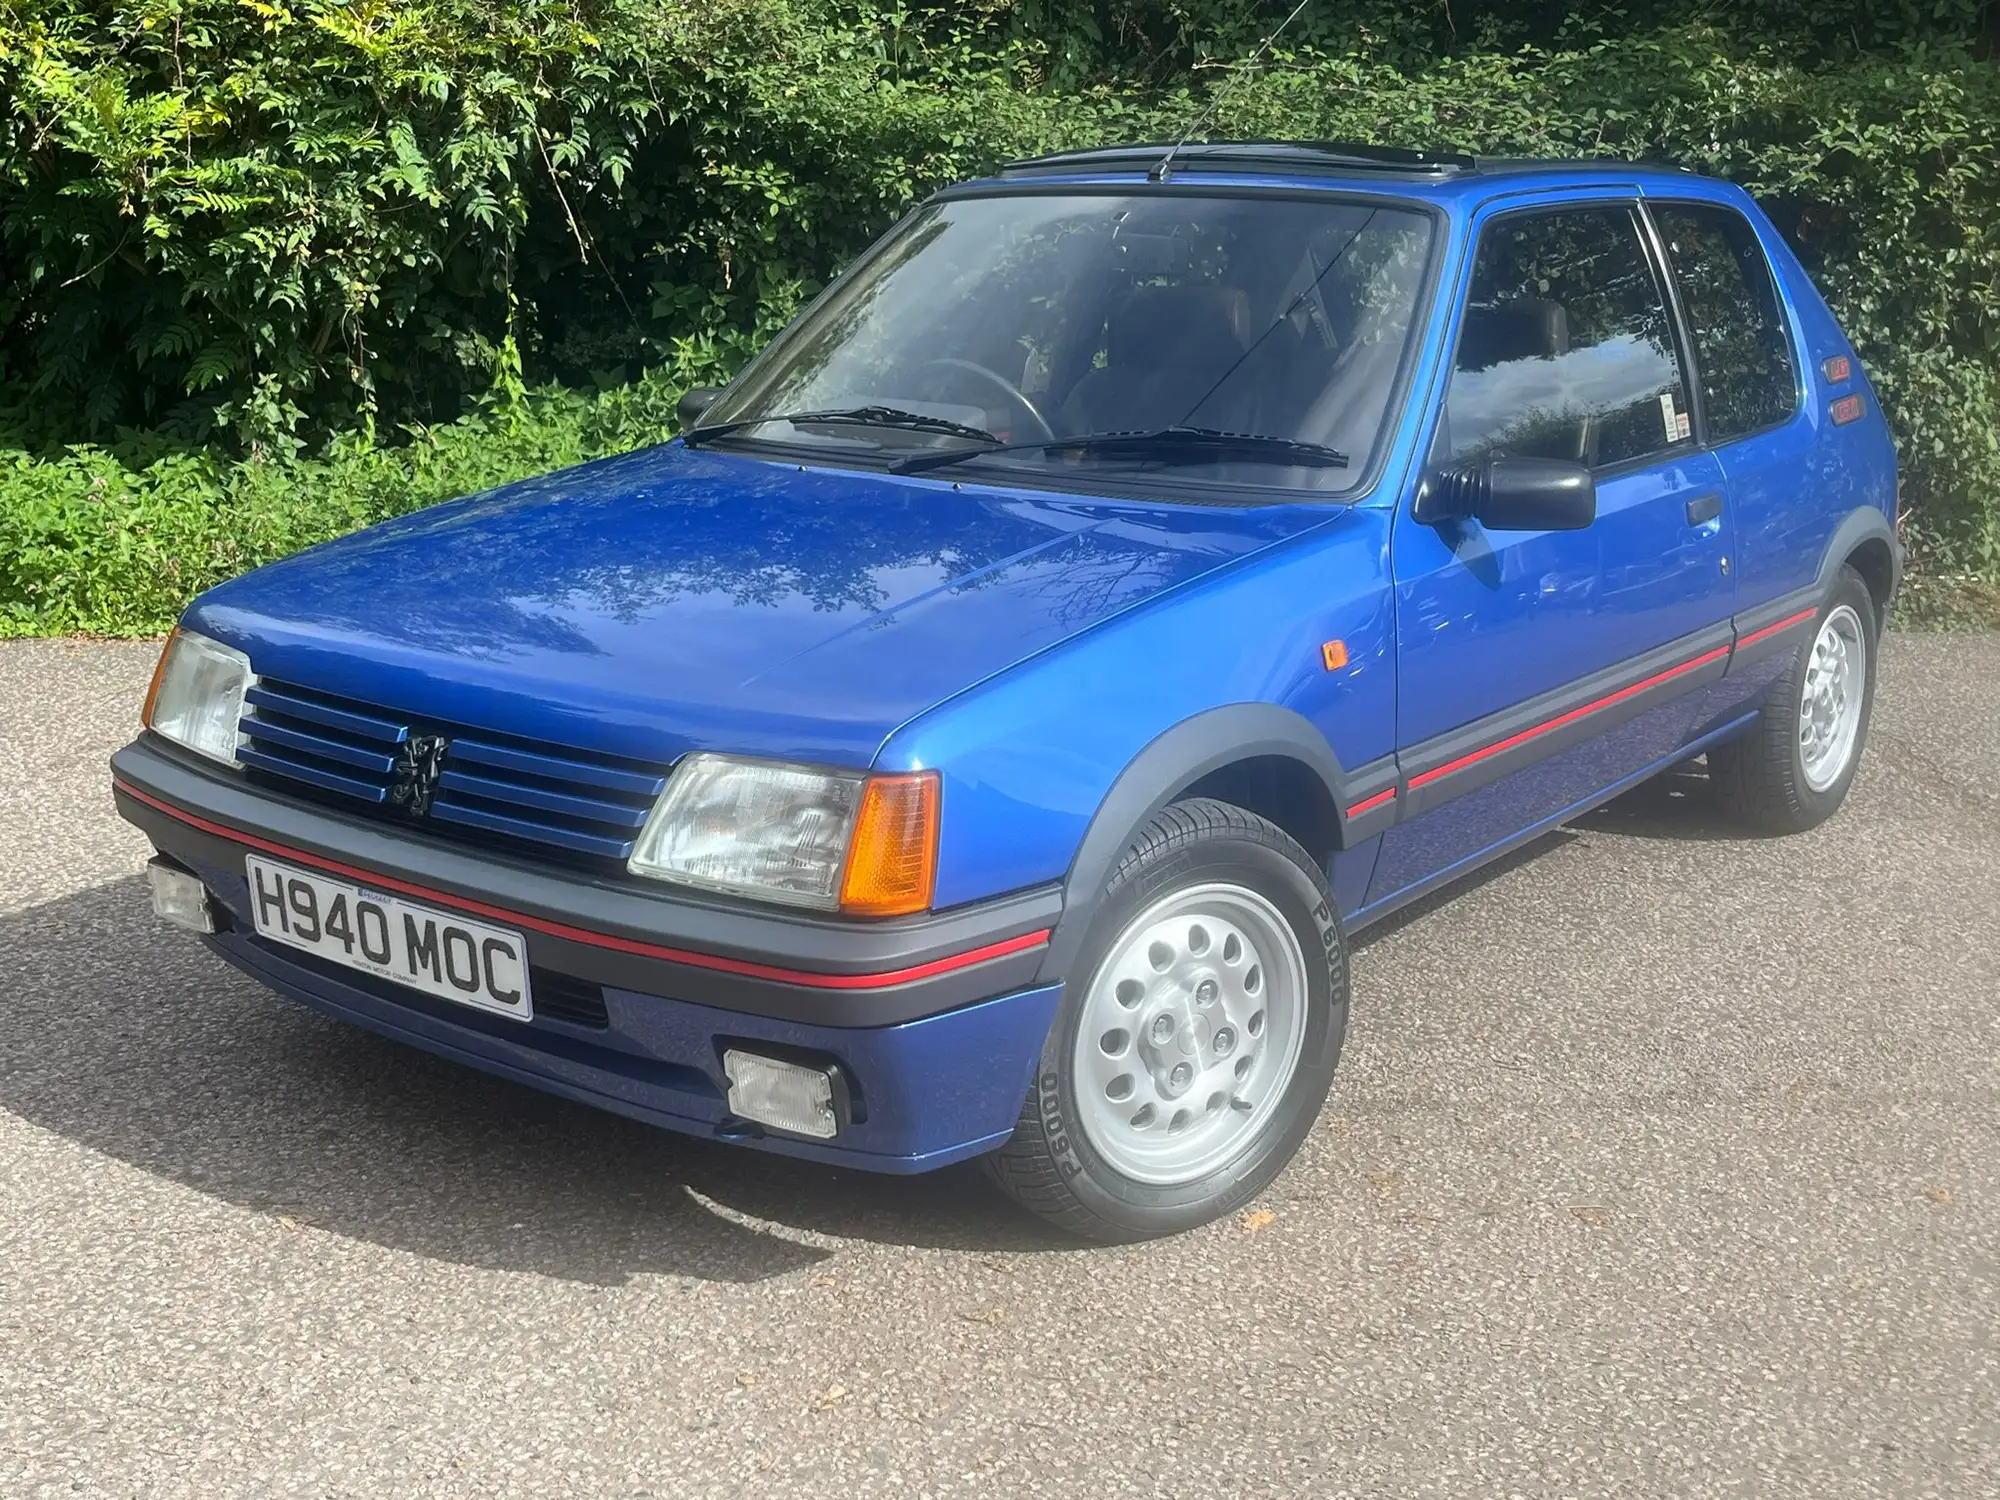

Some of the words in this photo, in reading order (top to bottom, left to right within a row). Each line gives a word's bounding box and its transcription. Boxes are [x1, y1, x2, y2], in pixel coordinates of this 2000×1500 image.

[255, 867, 391, 965] H940
[403, 913, 520, 1005] MOC
[1312, 900, 1343, 1006] P6000
[1040, 1072, 1082, 1179] P6000
